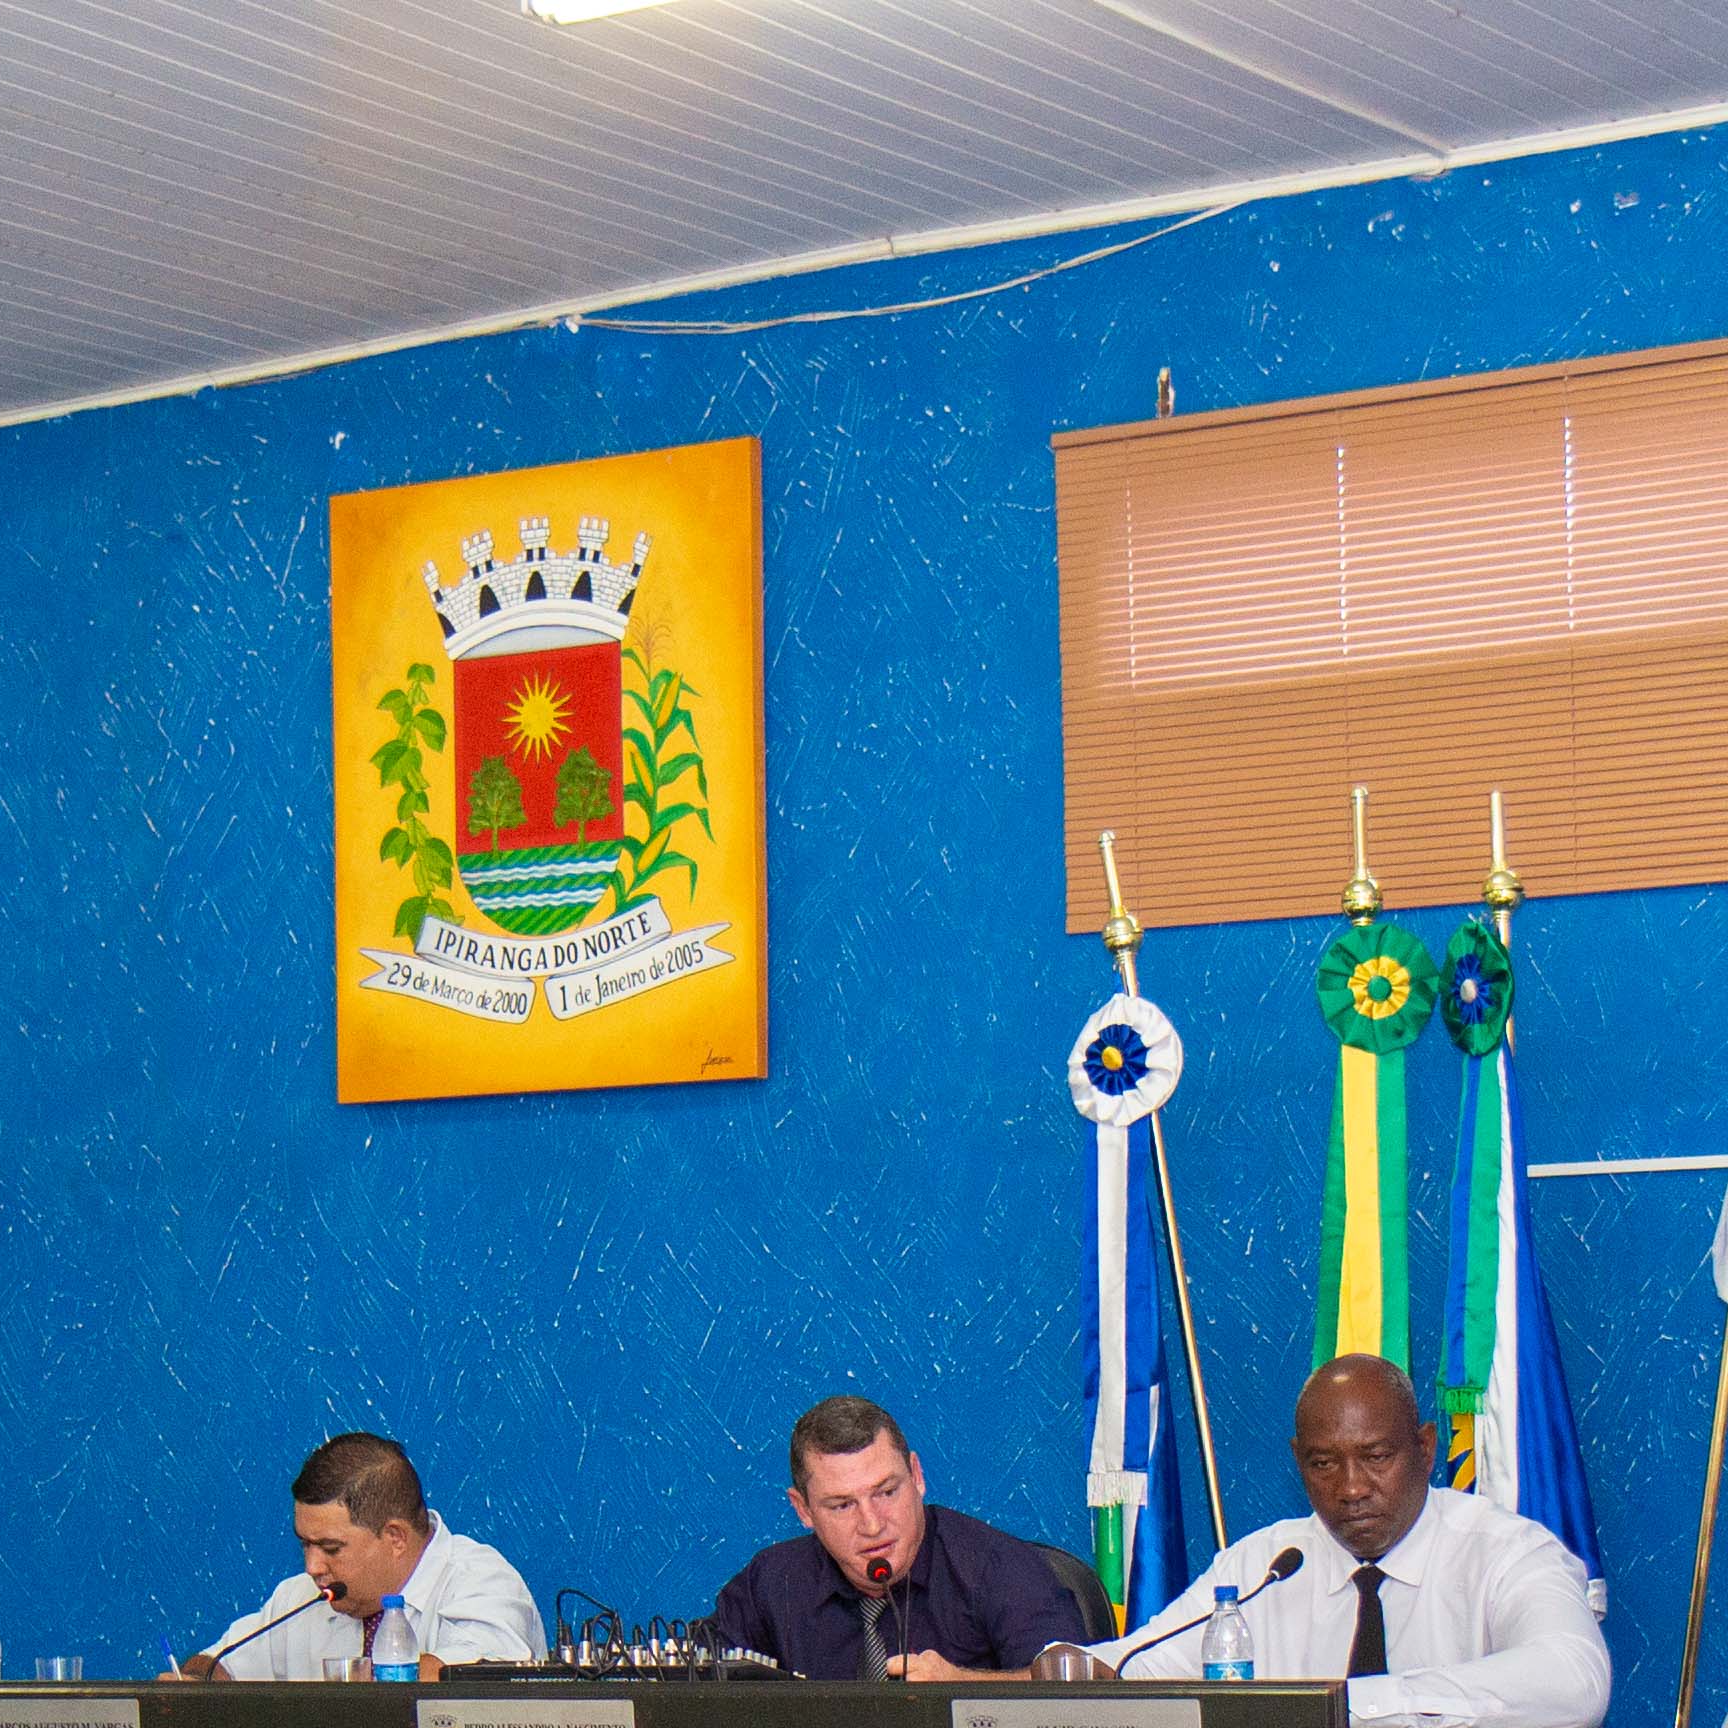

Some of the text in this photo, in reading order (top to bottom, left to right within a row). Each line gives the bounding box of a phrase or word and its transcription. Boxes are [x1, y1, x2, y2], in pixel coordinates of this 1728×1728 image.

[434, 910, 653, 972] IPIRANGA DO NORTE
[387, 962, 528, 1016] 29 de Março de 2000
[559, 940, 704, 1012] 1 de Janeiro de 2005
